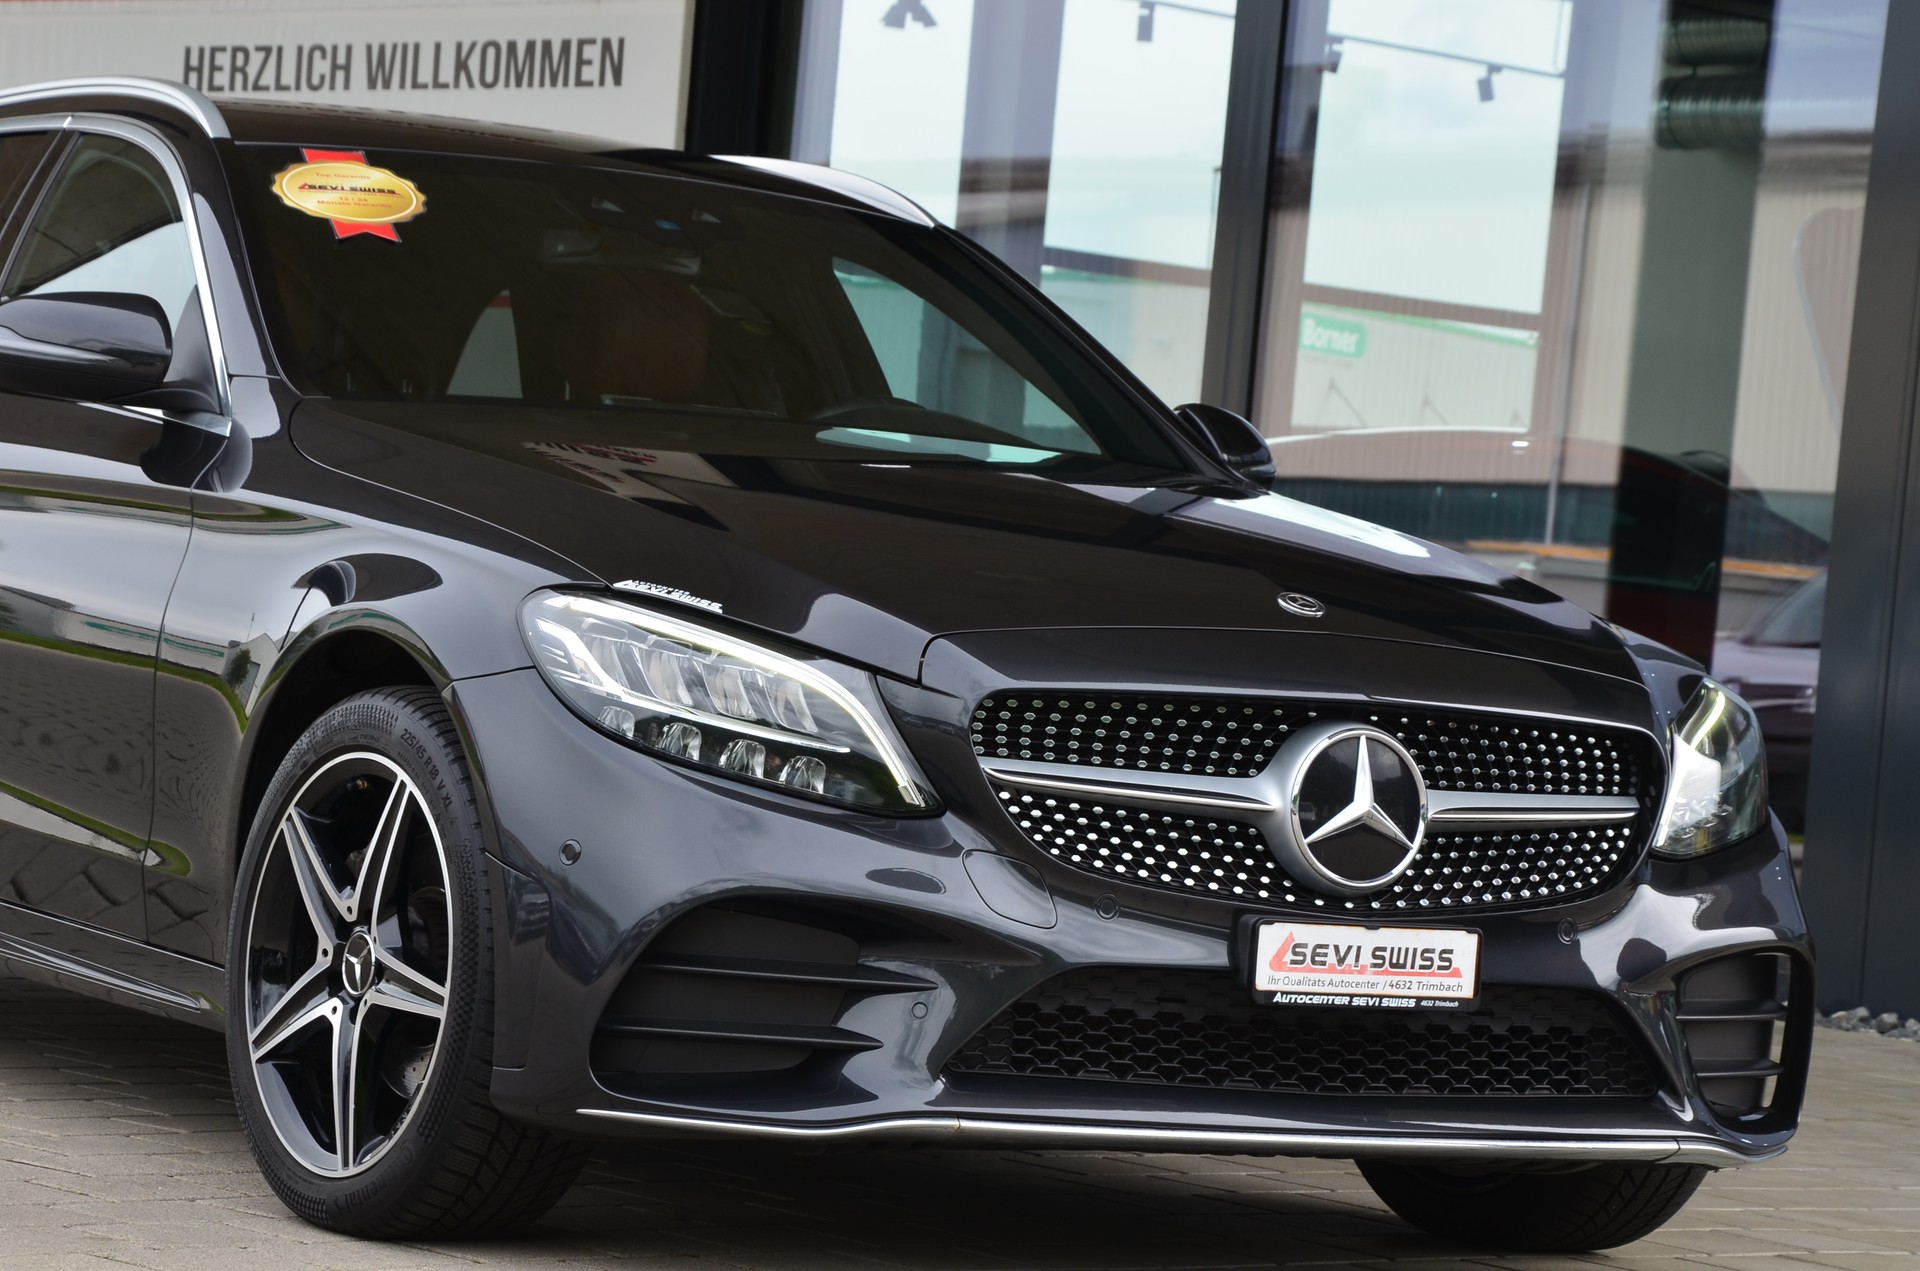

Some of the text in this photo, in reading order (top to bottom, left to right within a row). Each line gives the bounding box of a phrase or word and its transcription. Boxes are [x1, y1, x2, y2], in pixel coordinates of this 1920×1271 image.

[183, 37, 626, 92] HERZLICH WILLKOMMEN
[400, 728, 426, 760] 225/45
[423, 757, 433, 770] R
[429, 764, 440, 781] 18
[441, 792, 453, 812] XL
[1289, 942, 1455, 971] SEVI SWISS
[1267, 975, 1281, 986] Ihr
[1327, 978, 1380, 989] Autocenter
[1416, 981, 1463, 993] Trimbach
[1273, 992, 1350, 1006] AUTOCENTER
[1351, 997, 1380, 1006] SEVI
[1381, 998, 1417, 1008] SWISS
[344, 1138, 416, 1214] Connental
